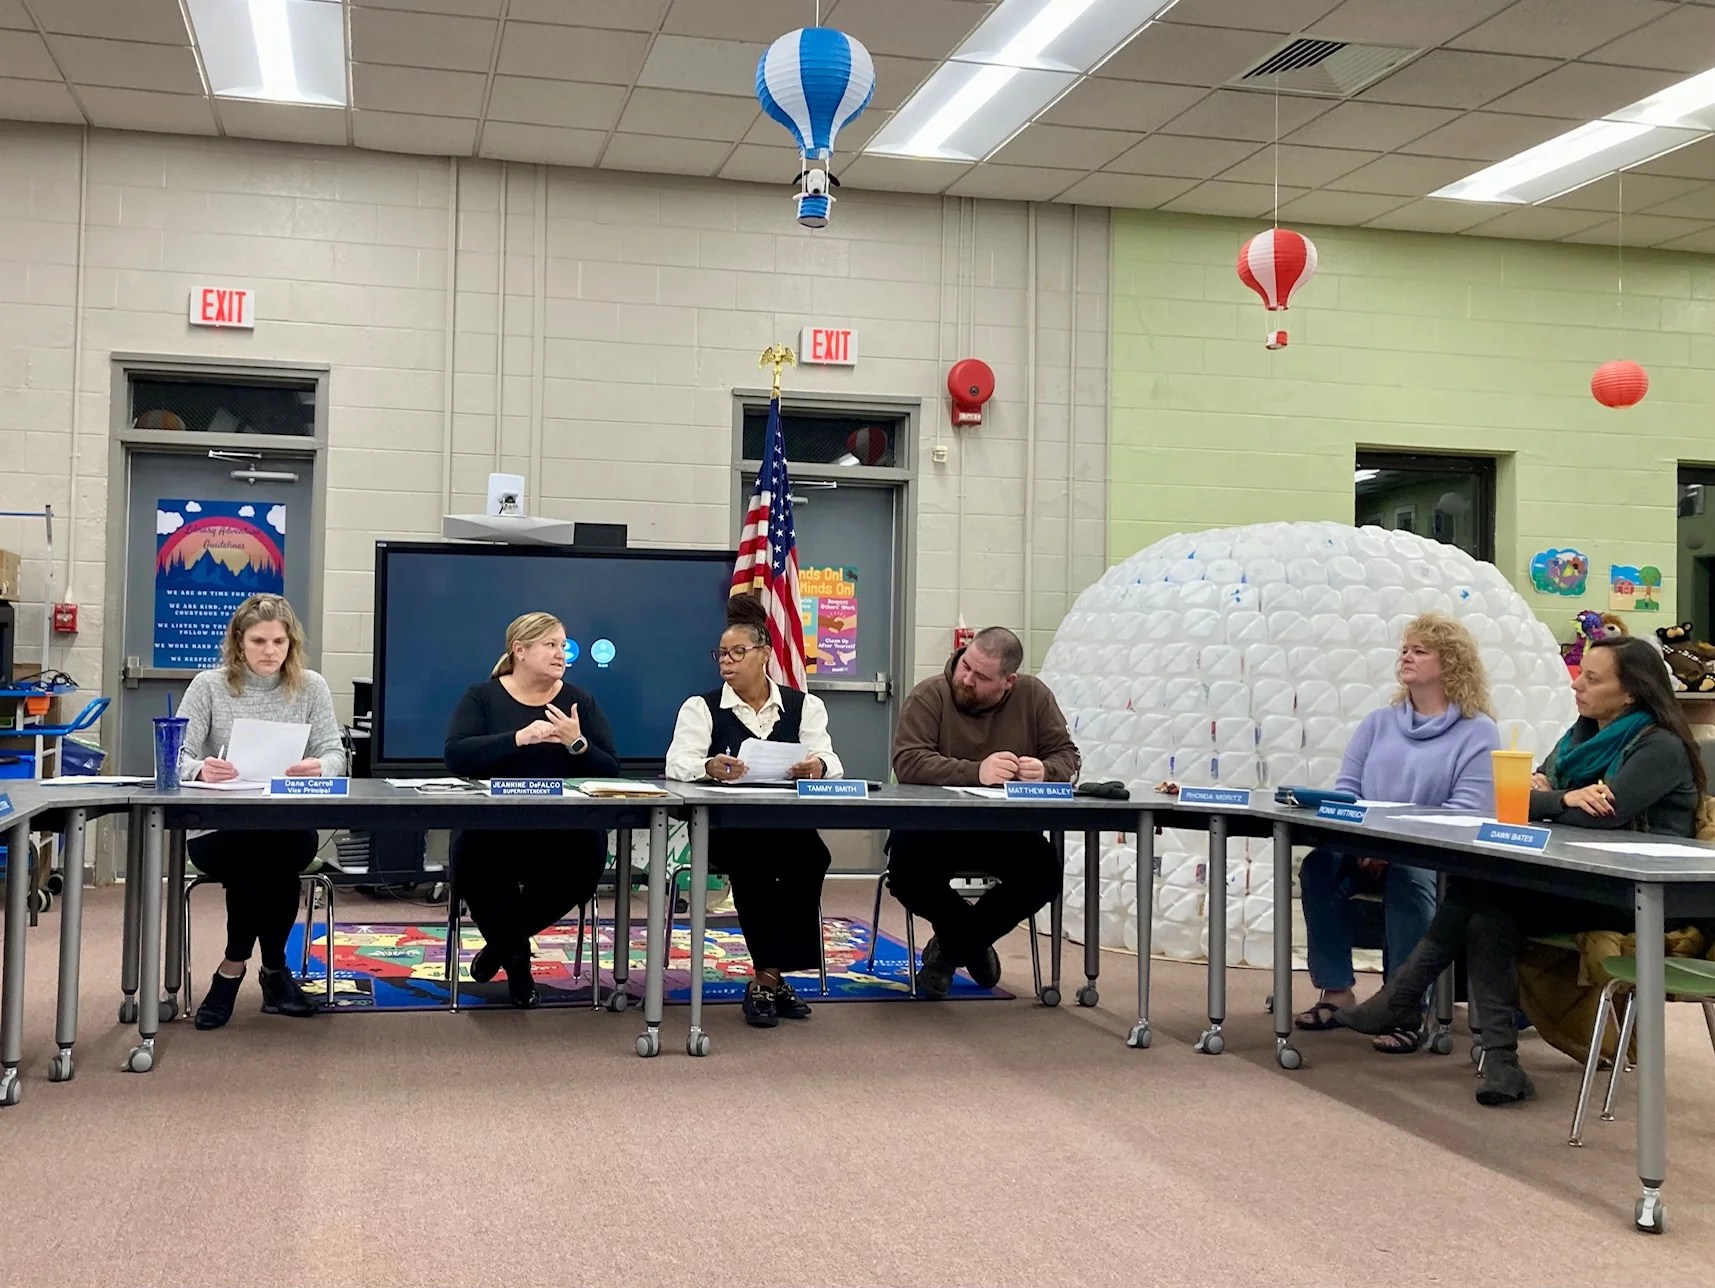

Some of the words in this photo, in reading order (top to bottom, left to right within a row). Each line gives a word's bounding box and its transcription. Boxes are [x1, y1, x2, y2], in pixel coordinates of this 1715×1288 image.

[202, 289, 246, 323] EXIT
[812, 329, 851, 361] EXIT
[184, 524, 217, 536] Library
[219, 526, 260, 535] Adventure
[203, 539, 245, 549] Guidelines
[798, 566, 820, 580] nds
[824, 567, 843, 581] On!
[800, 581, 833, 595] Minds
[836, 582, 855, 596] On!
[1186, 792, 1213, 800] RHONDA
[1215, 794, 1243, 802] MORITZ
[1490, 830, 1511, 840] DAWN
[1511, 833, 1534, 843] BATES
